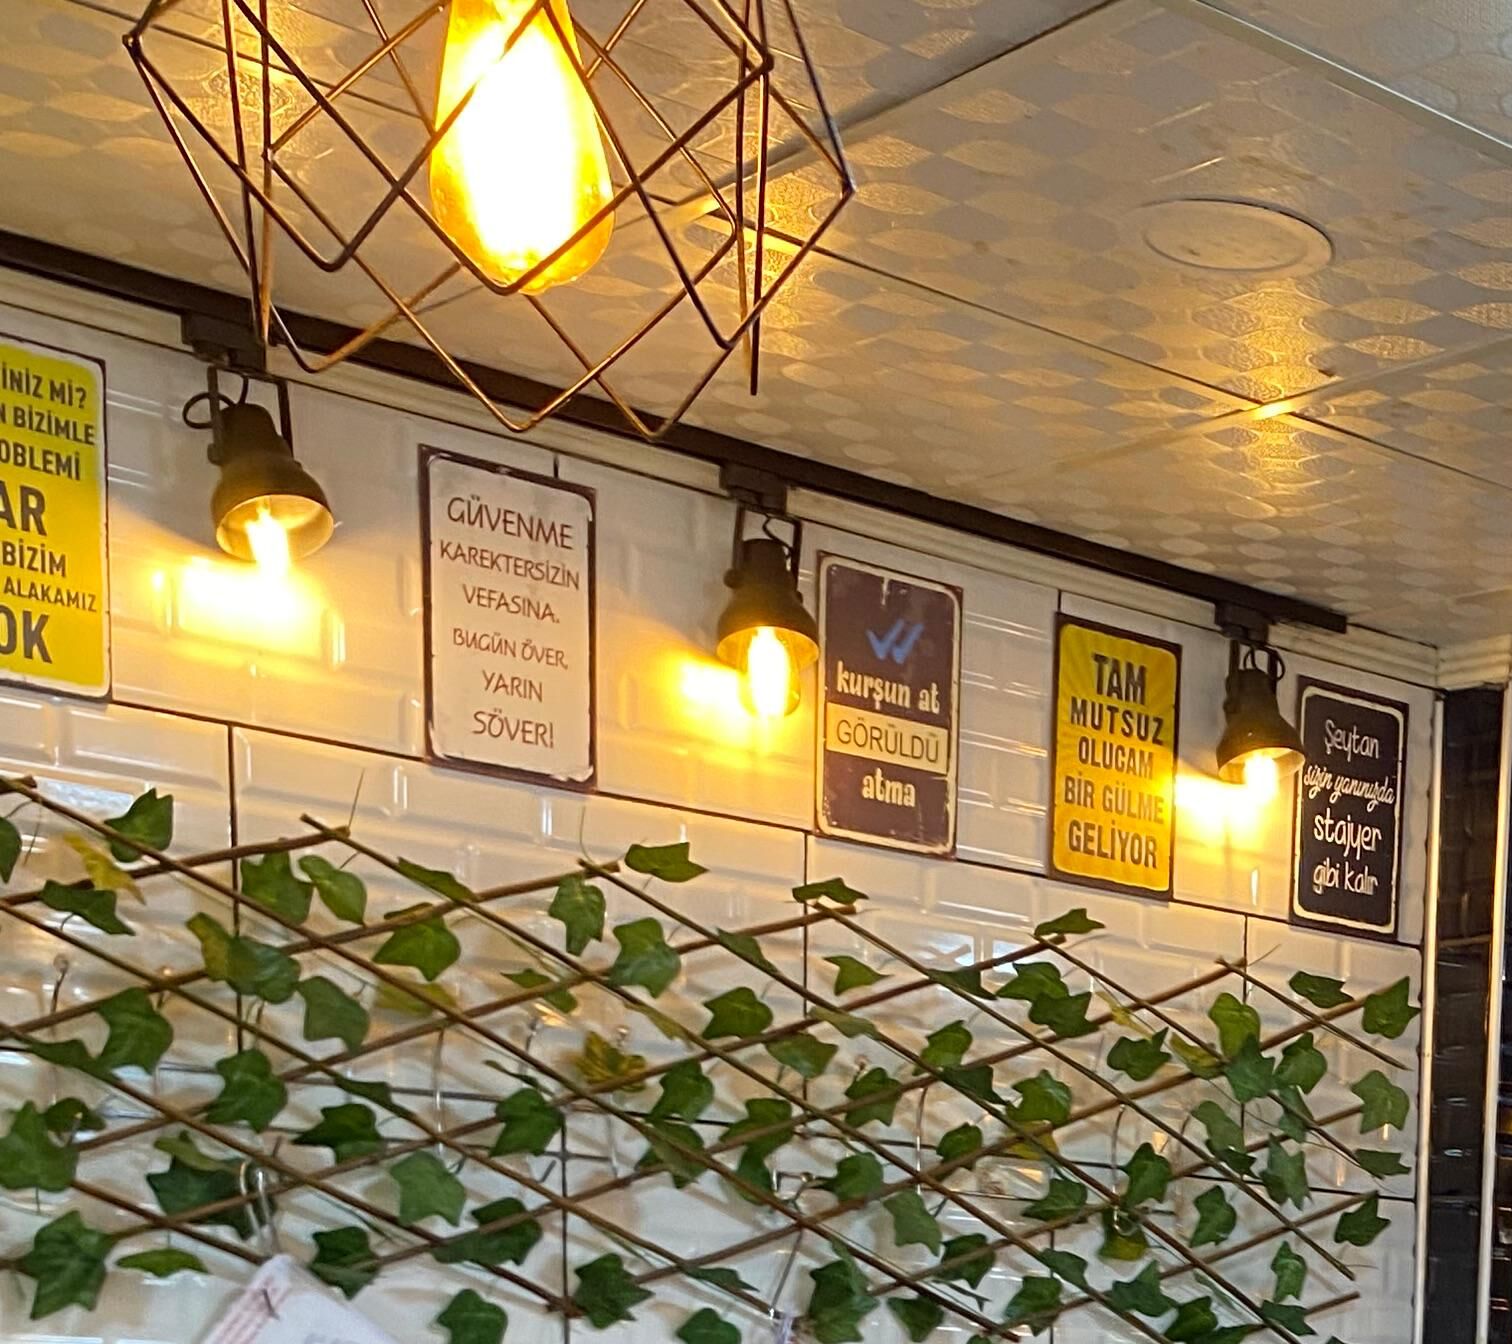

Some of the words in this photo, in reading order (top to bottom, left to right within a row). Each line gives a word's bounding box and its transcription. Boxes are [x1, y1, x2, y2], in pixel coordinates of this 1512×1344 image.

[50, 377, 86, 409] Mİ?
[14, 405, 95, 445] BİZİMLE
[447, 495, 573, 550] GÜVENME
[2, 539, 66, 578] BİZİM
[440, 540, 579, 590] KAREKTERSİZİN
[4, 576, 97, 612] ALAKAMIZ
[453, 628, 516, 658] BUGÜN
[482, 670, 542, 702] YARIN
[836, 660, 911, 710] kurşun
[919, 682, 940, 714] at
[1092, 654, 1147, 706] TAM
[473, 708, 553, 748] SÖVER!
[837, 716, 939, 763] GÖRÜLDÜ
[1071, 697, 1164, 746] MUTSUZ
[1325, 719, 1379, 762] Şeytan
[1078, 737, 1153, 780] OLUCAM
[862, 767, 916, 807] atma
[1064, 771, 1095, 809] BİR
[1102, 779, 1164, 824] GÜLME
[1069, 819, 1157, 869] GELİYOR
[1314, 808, 1382, 859] stajyer
[1314, 858, 1340, 895] gibi
